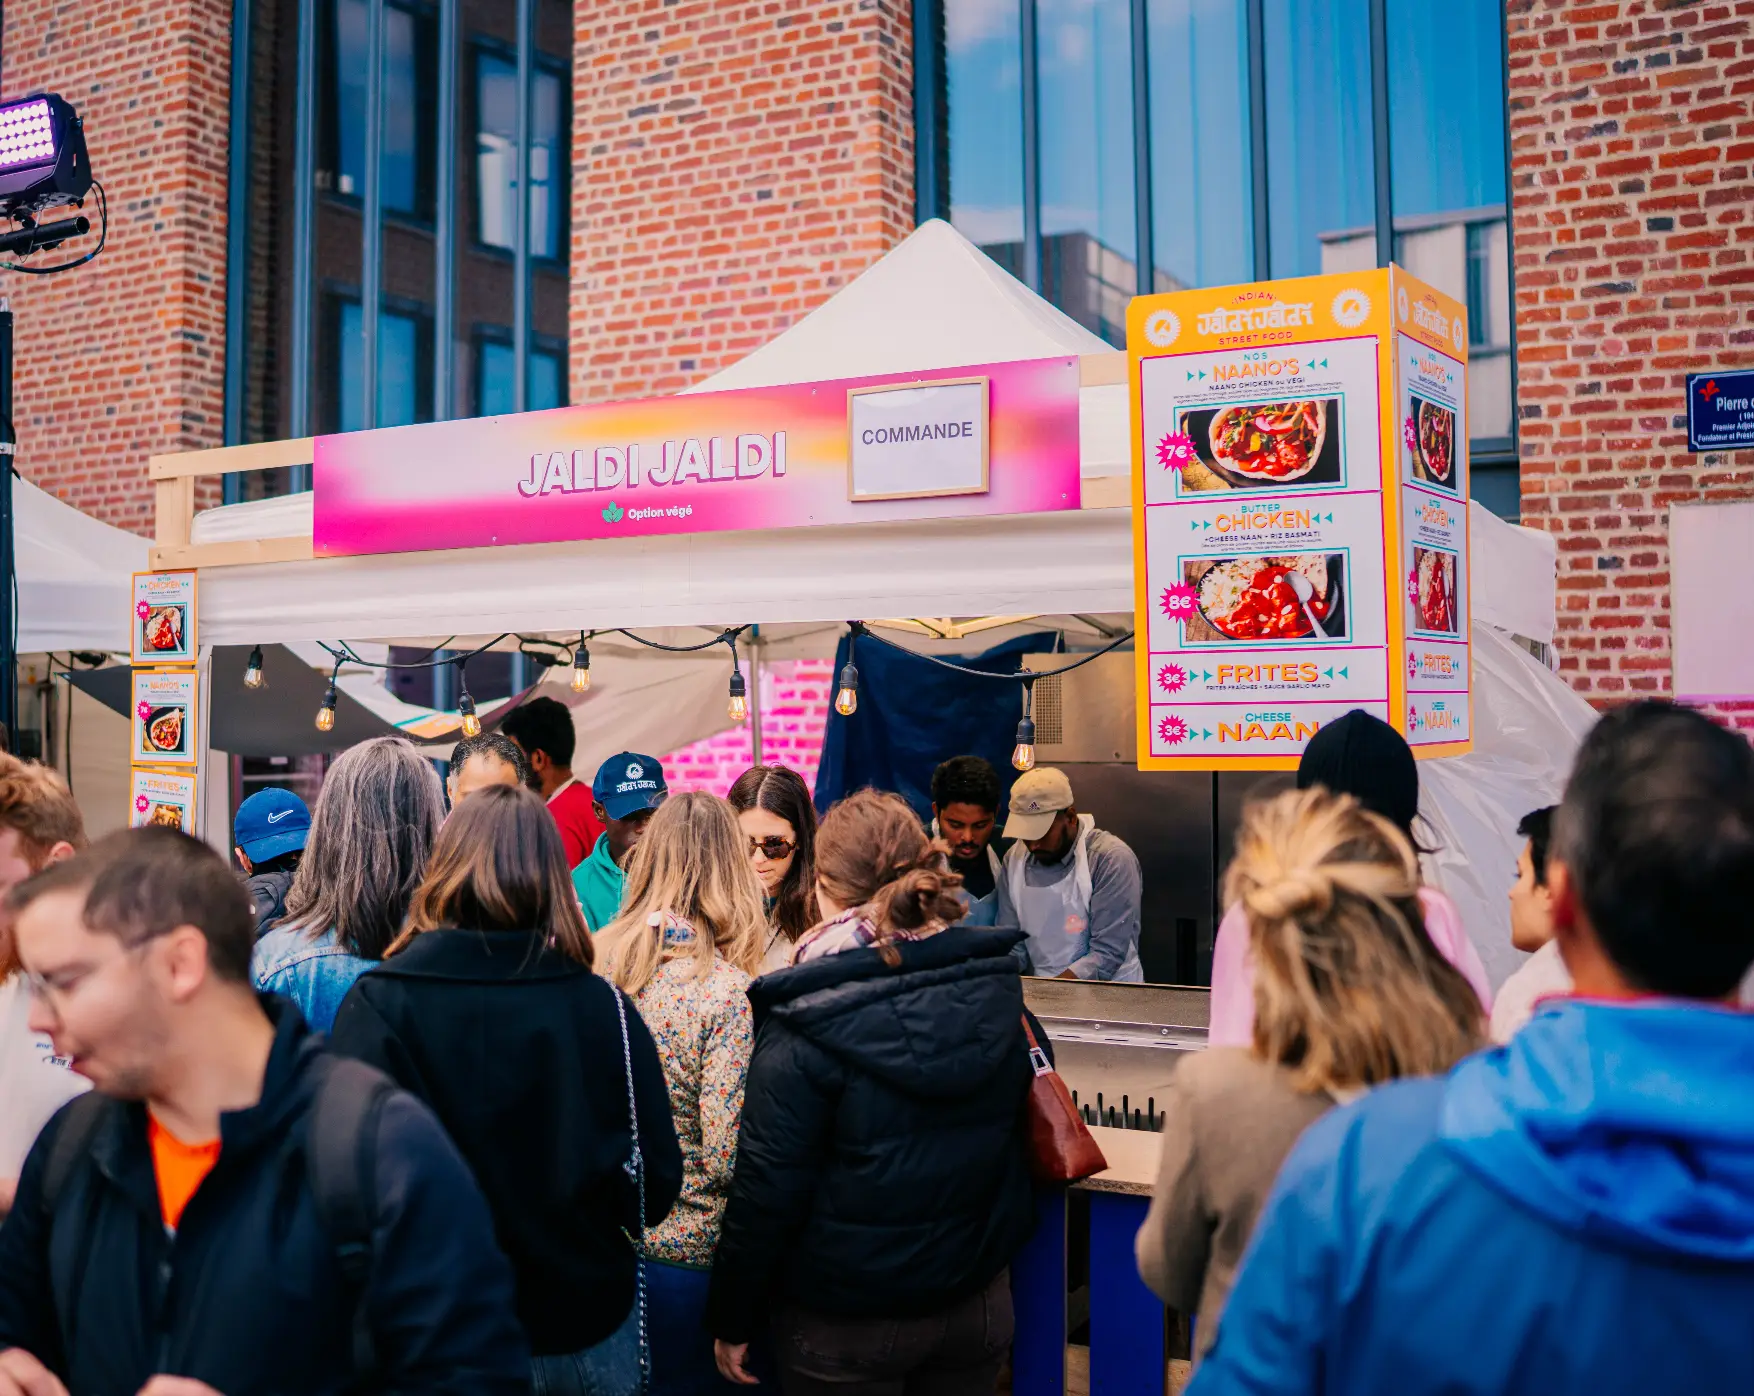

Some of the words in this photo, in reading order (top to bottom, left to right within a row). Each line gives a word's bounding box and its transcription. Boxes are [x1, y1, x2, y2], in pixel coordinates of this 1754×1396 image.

[1234, 292, 1274, 304] INDIAN
[1219, 334, 1259, 346] STREET
[1262, 331, 1294, 341] FOOD
[1243, 352, 1268, 361] NOS
[1213, 358, 1300, 383] NAANO'S
[1209, 383, 1237, 391] NAANO
[1239, 380, 1274, 389] CHICKEN
[1716, 397, 1749, 411] Pierre
[862, 421, 974, 446] COMMANDE
[1712, 423, 1736, 431] Premier
[1698, 433, 1728, 442] Fondateur
[1165, 445, 1188, 459] 7€
[518, 443, 640, 498] JALDI
[647, 431, 787, 487] JALDI
[628, 506, 664, 521] Option
[666, 504, 693, 519] végé
[1241, 503, 1281, 513] BUTTER
[1215, 509, 1311, 533] CHICKEN
[1285, 530, 1321, 538] BASMATI
[1168, 594, 1192, 610] 8€
[1164, 673, 1181, 684] 3€
[1217, 662, 1319, 684] FRITES
[1245, 712, 1292, 722] CHEESE
[1165, 725, 1181, 736] 3€
[1217, 721, 1320, 743] NAAN
